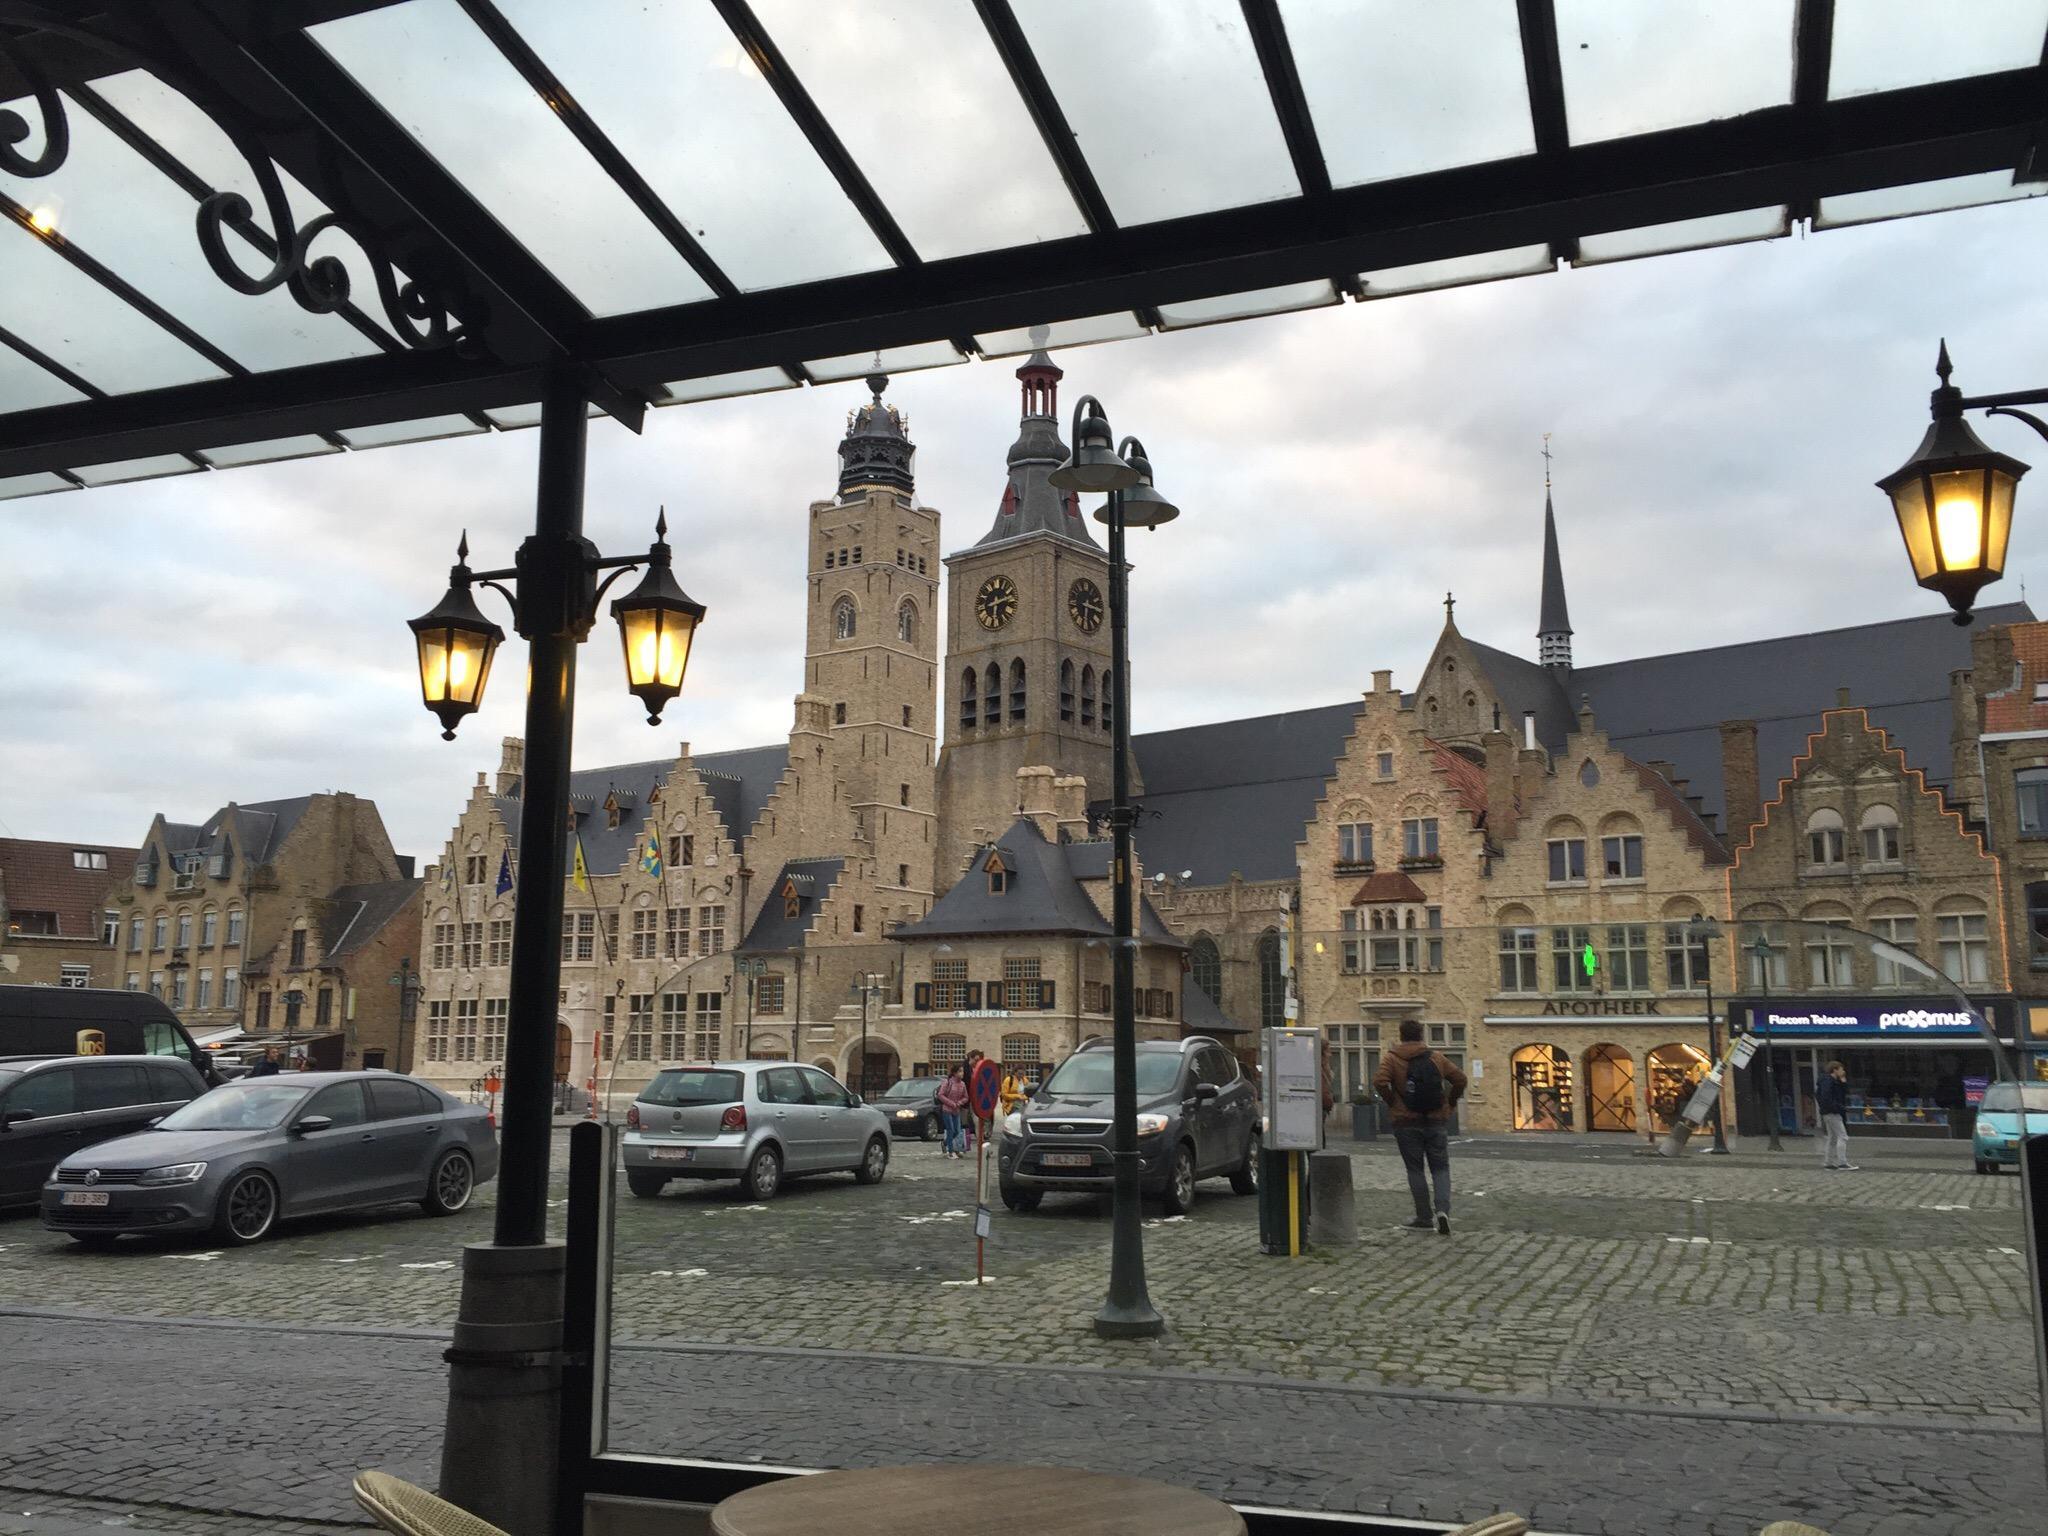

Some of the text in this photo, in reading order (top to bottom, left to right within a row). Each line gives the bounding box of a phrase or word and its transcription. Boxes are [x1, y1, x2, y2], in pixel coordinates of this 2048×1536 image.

[1542, 1000, 1662, 1015] APOTHEEK
[1768, 1014, 1810, 1025] Flocom
[1810, 1014, 1858, 1025] Telecom
